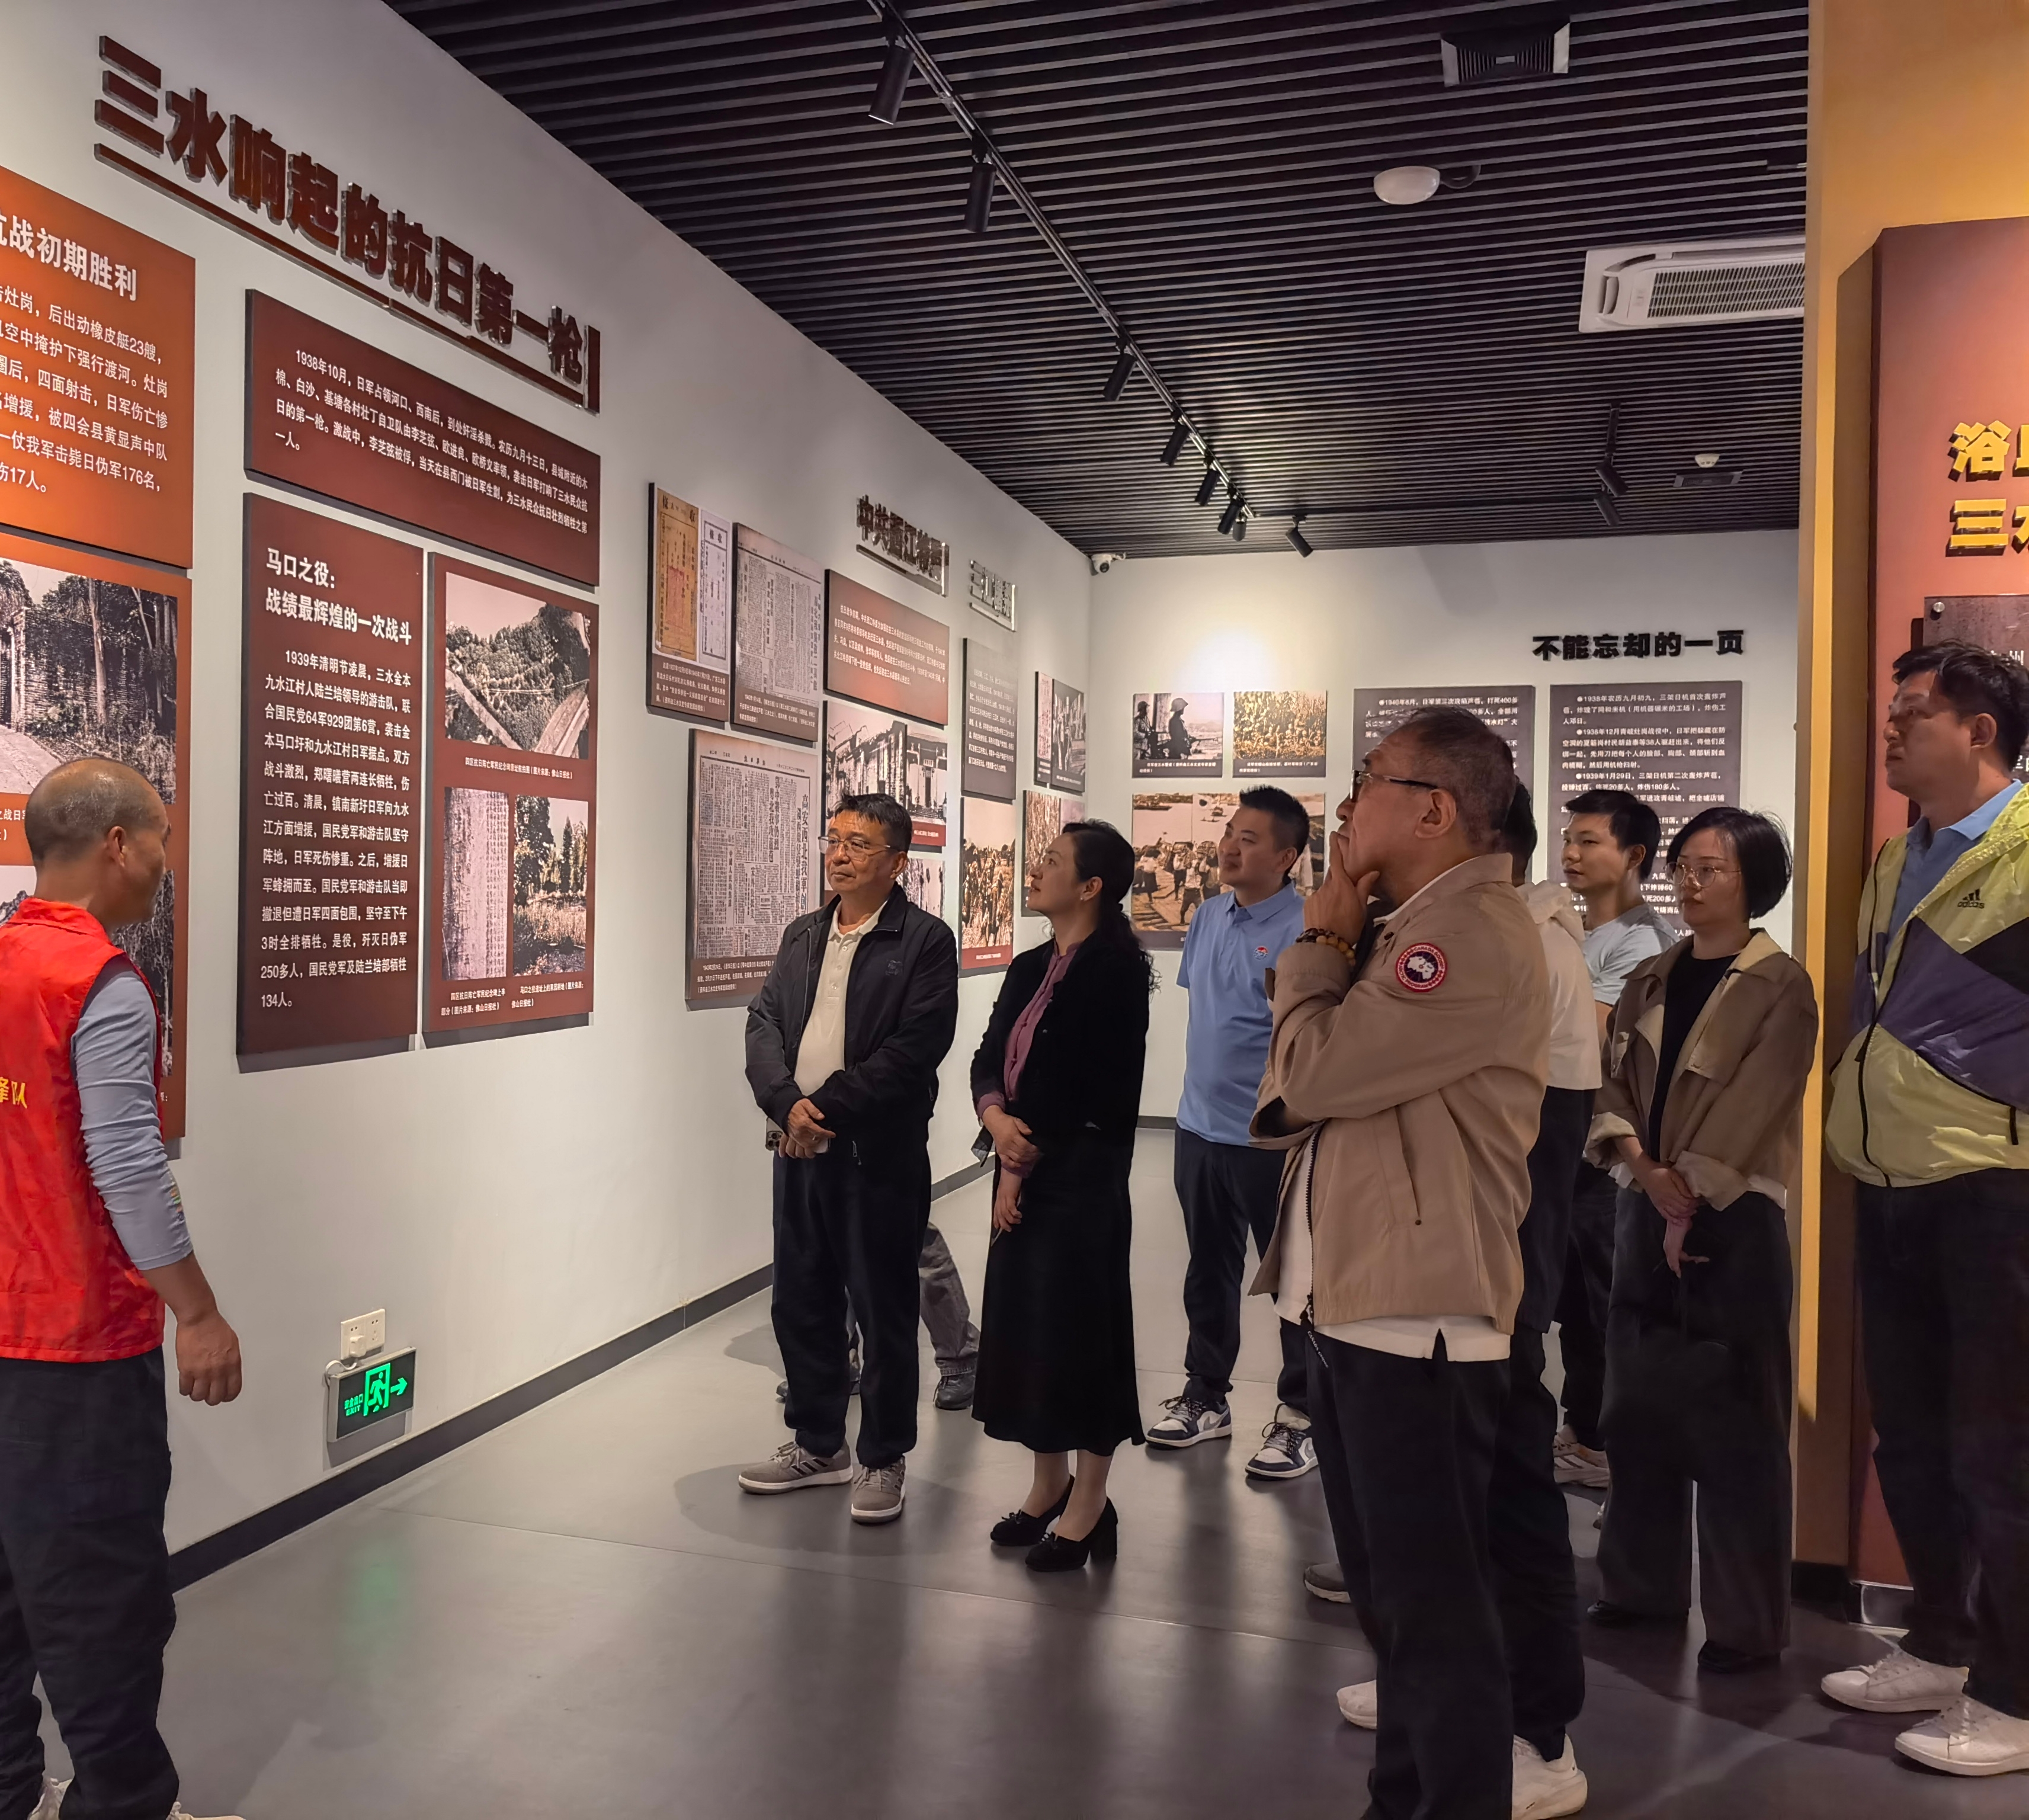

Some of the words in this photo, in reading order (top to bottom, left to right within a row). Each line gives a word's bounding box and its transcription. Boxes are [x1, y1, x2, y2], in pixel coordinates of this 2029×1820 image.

[95, 35, 583, 384] 三水响起的抗日第一枪
[0, 320, 168, 398] 空中掩护下强行渡河。灶岗
[275, 431, 300, 451] 一人。
[1950, 419, 2029, 474] 浴
[1949, 498, 2029, 548] 三
[267, 548, 335, 588] 马口之役：
[266, 587, 412, 645] 战绩最辉煌的一次战斗
[1533, 629, 1744, 662] 不能忘却的一页
[286, 651, 411, 687] 1939年清明节凌晨，三水金本
[265, 674, 411, 713] 九水江村人陆兰培领导的游击队，联
[265, 703, 411, 739] 合国民党64军929团第6营，袭击金
[265, 732, 410, 765] 本马口圩和九水江村日军据点。双方
[264, 790, 409, 816] 亡过百。清晨，镇南新圩日军向九水
[264, 820, 409, 842] 江方面增援，国民党军和游击队坚守
[263, 848, 408, 868] 阵地，日军死伤惨重。之后，增援日
[262, 877, 408, 893] 军蜂拥而至。国民党军和游击队当即
[262, 906, 408, 921] 撤退但遭日军四面包围，坚守至下午
[1957, 901, 1985, 909] adidas
[261, 932, 407, 950] 3时全排牺牲。是役，歼灭日伪军
[261, 957, 406, 979] 250多人，国民党军及陆兰培部牺牲
[261, 991, 292, 1008] 134人。
[344, 1393, 363, 1410] 安全出口
[346, 1405, 361, 1417] EXIT
